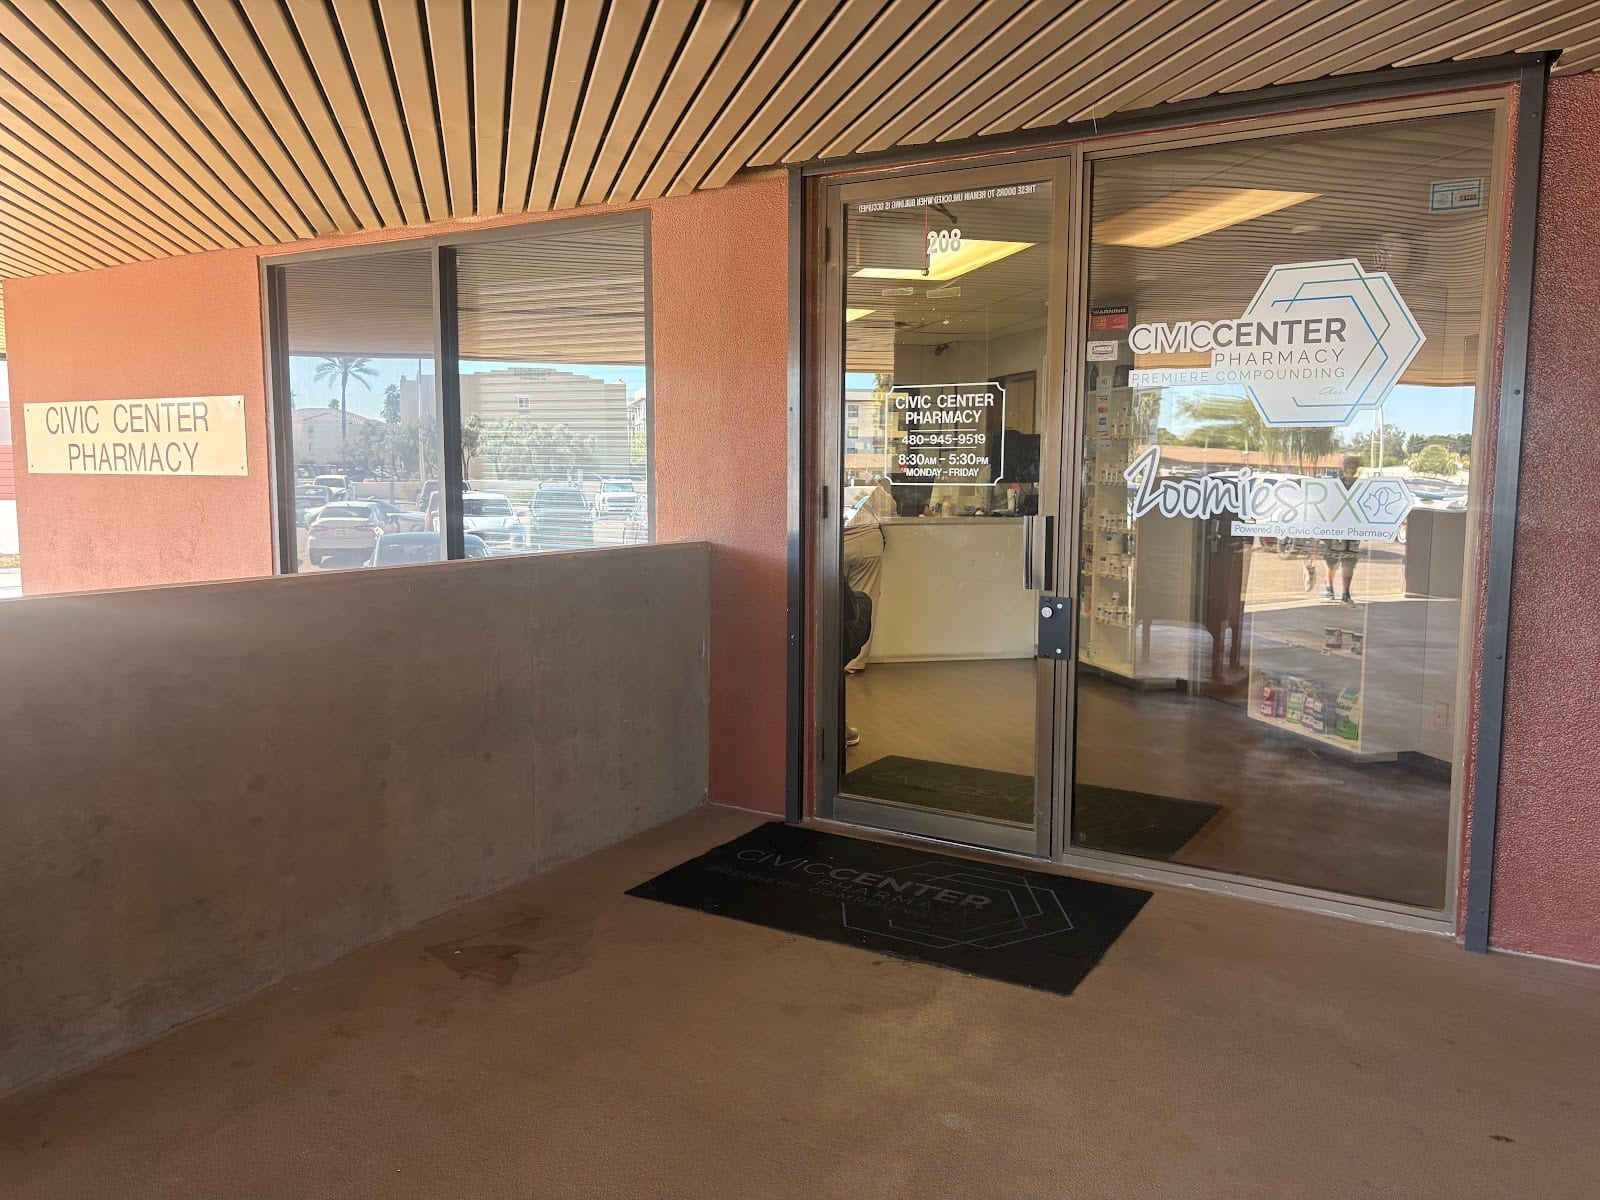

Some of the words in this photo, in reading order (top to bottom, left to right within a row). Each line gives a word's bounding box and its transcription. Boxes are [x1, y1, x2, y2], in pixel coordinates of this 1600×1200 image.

[926, 228, 962, 254] 208
[1132, 317, 1347, 351] CIVICCENTER
[1215, 348, 1345, 367] PHARMACY
[1132, 371, 1209, 384] PREMIERE
[1216, 367, 1346, 382] COMPOUNDING
[895, 394, 932, 409] CIVIC
[936, 393, 995, 408] CENTER
[45, 405, 100, 435] CIVIC
[113, 401, 209, 434] CENTER
[905, 410, 982, 425] PHARMACY
[901, 433, 986, 445] 480-945-9519
[67, 441, 199, 473] PHARMACY
[898, 453, 937, 466] 8:30AM
[948, 453, 989, 465] 5:30PM
[1234, 524, 1273, 535] Powered
[1274, 525, 1287, 537] By
[1288, 525, 1310, 536] Civic
[1312, 526, 1345, 537] Center
[1347, 527, 1395, 540] Pharmacy
[736, 848, 992, 910] CIVICCENTER
